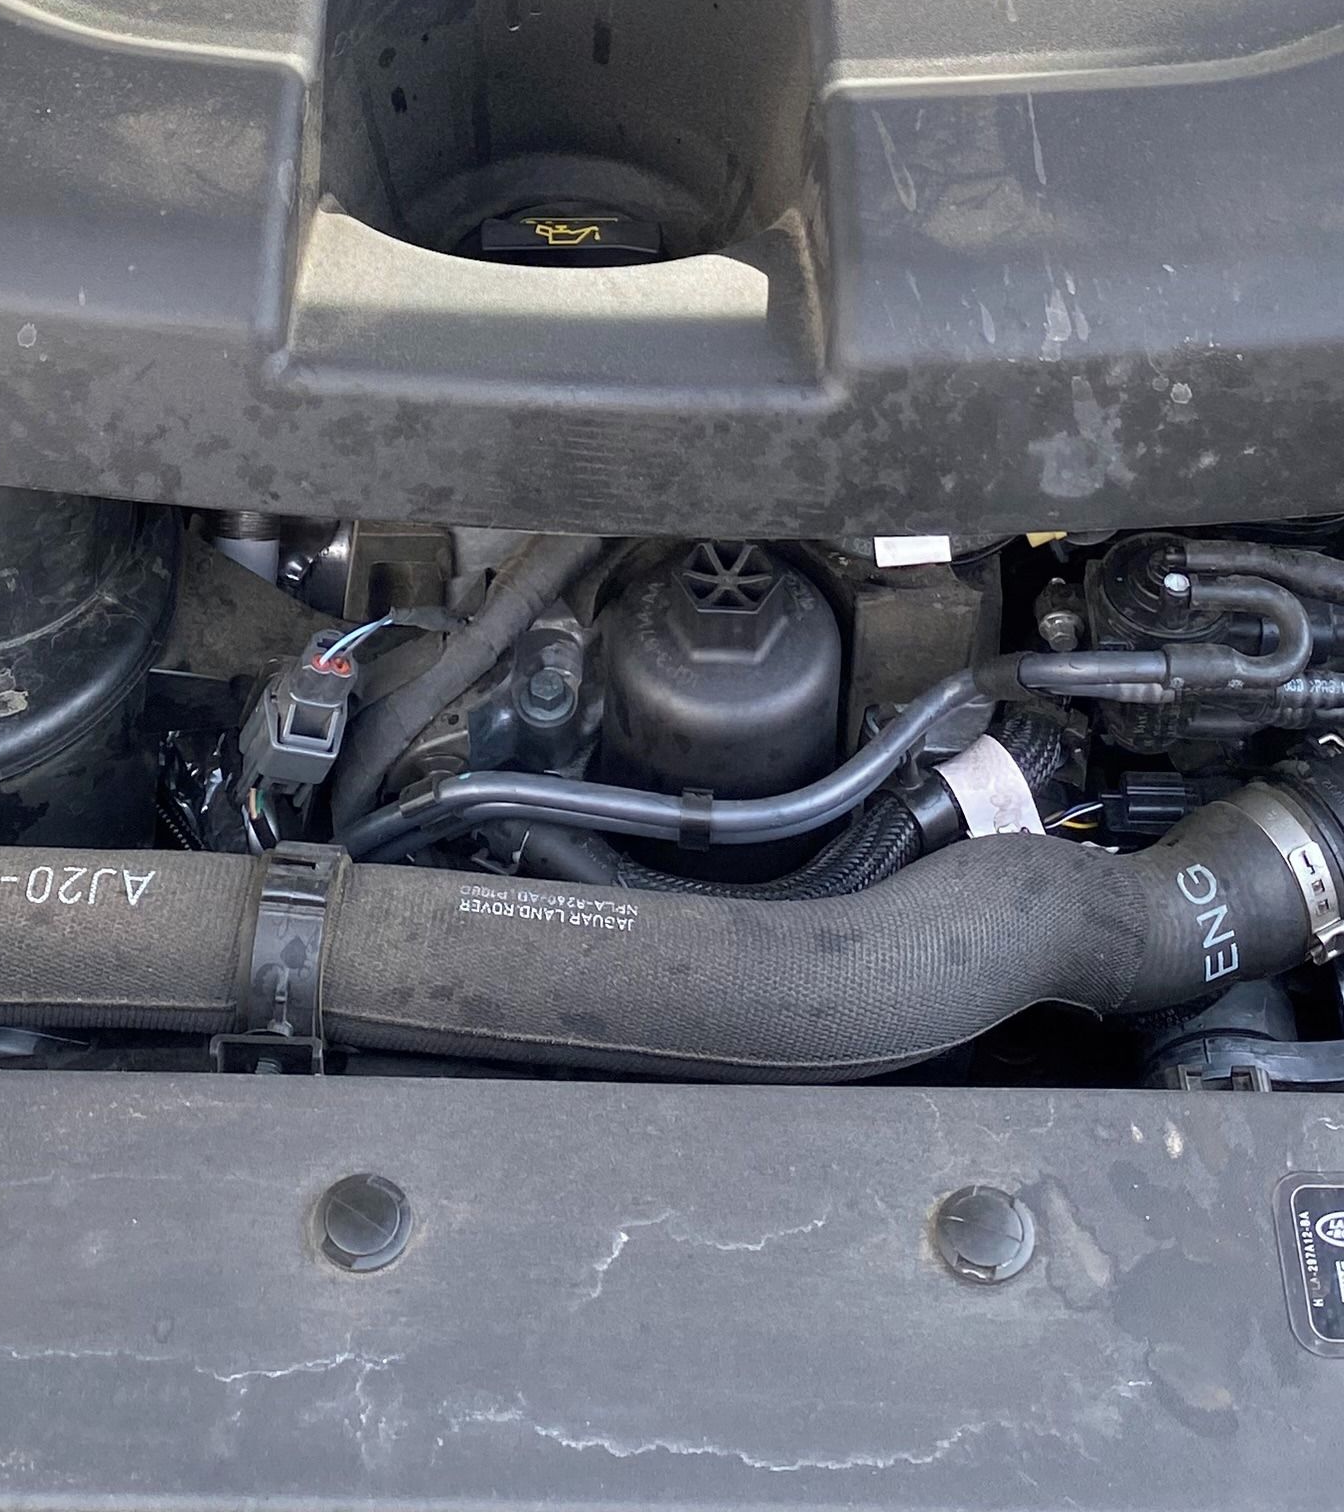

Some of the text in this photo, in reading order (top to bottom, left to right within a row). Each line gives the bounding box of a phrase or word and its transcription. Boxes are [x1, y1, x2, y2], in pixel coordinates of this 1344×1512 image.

[459, 898, 514, 917] ROVER
[569, 911, 635, 931] JAGUAR
[1177, 863, 1239, 982] ENG
